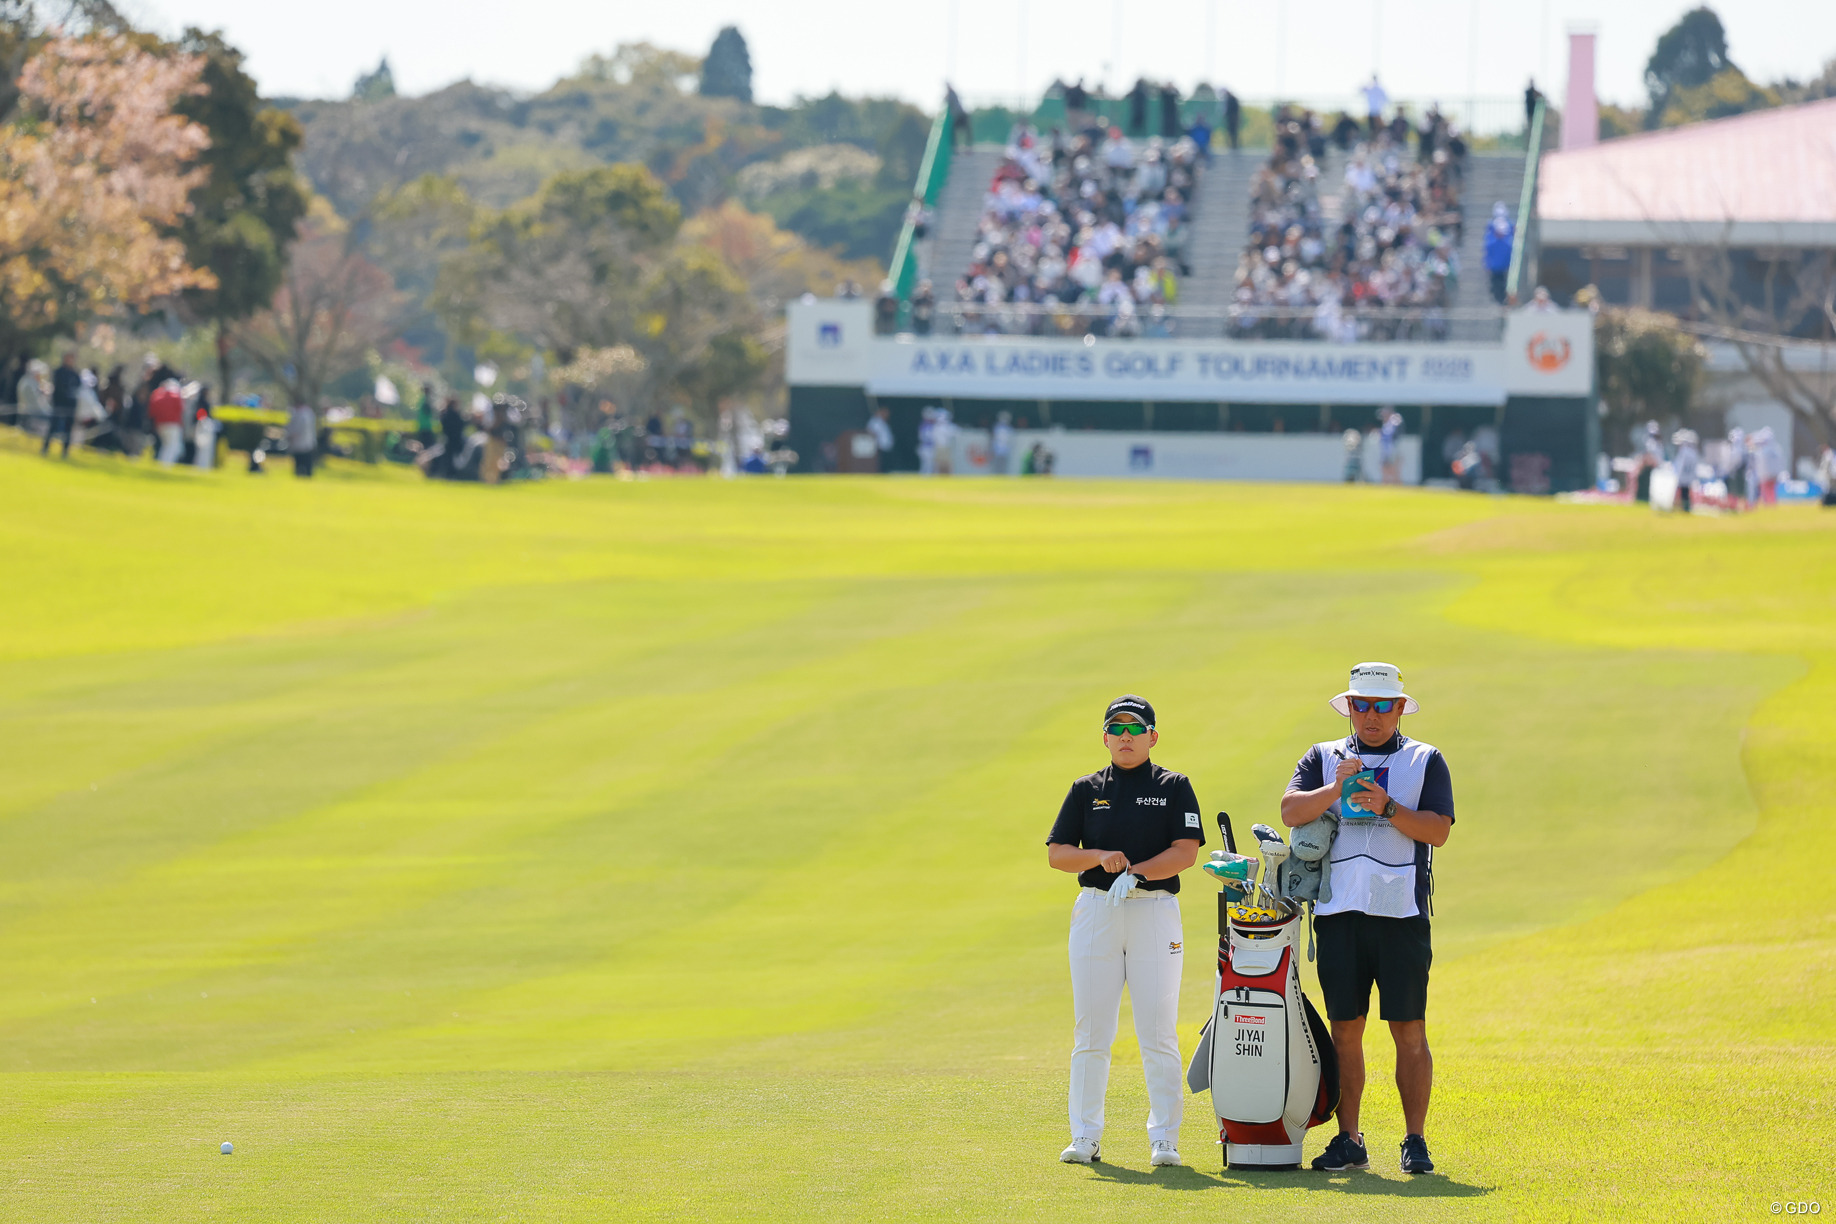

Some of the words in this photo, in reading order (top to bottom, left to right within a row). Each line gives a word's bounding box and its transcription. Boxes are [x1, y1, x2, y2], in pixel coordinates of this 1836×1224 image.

[911, 352, 977, 375] AXA
[986, 352, 1094, 376] LADIES
[1103, 353, 1183, 377] GOLF
[1196, 354, 1410, 379] TOURNAMENT
[1136, 797, 1166, 806] 두산건설
[1235, 1015, 1265, 1024] ThreeBond
[1235, 1043, 1263, 1057] SHIN
